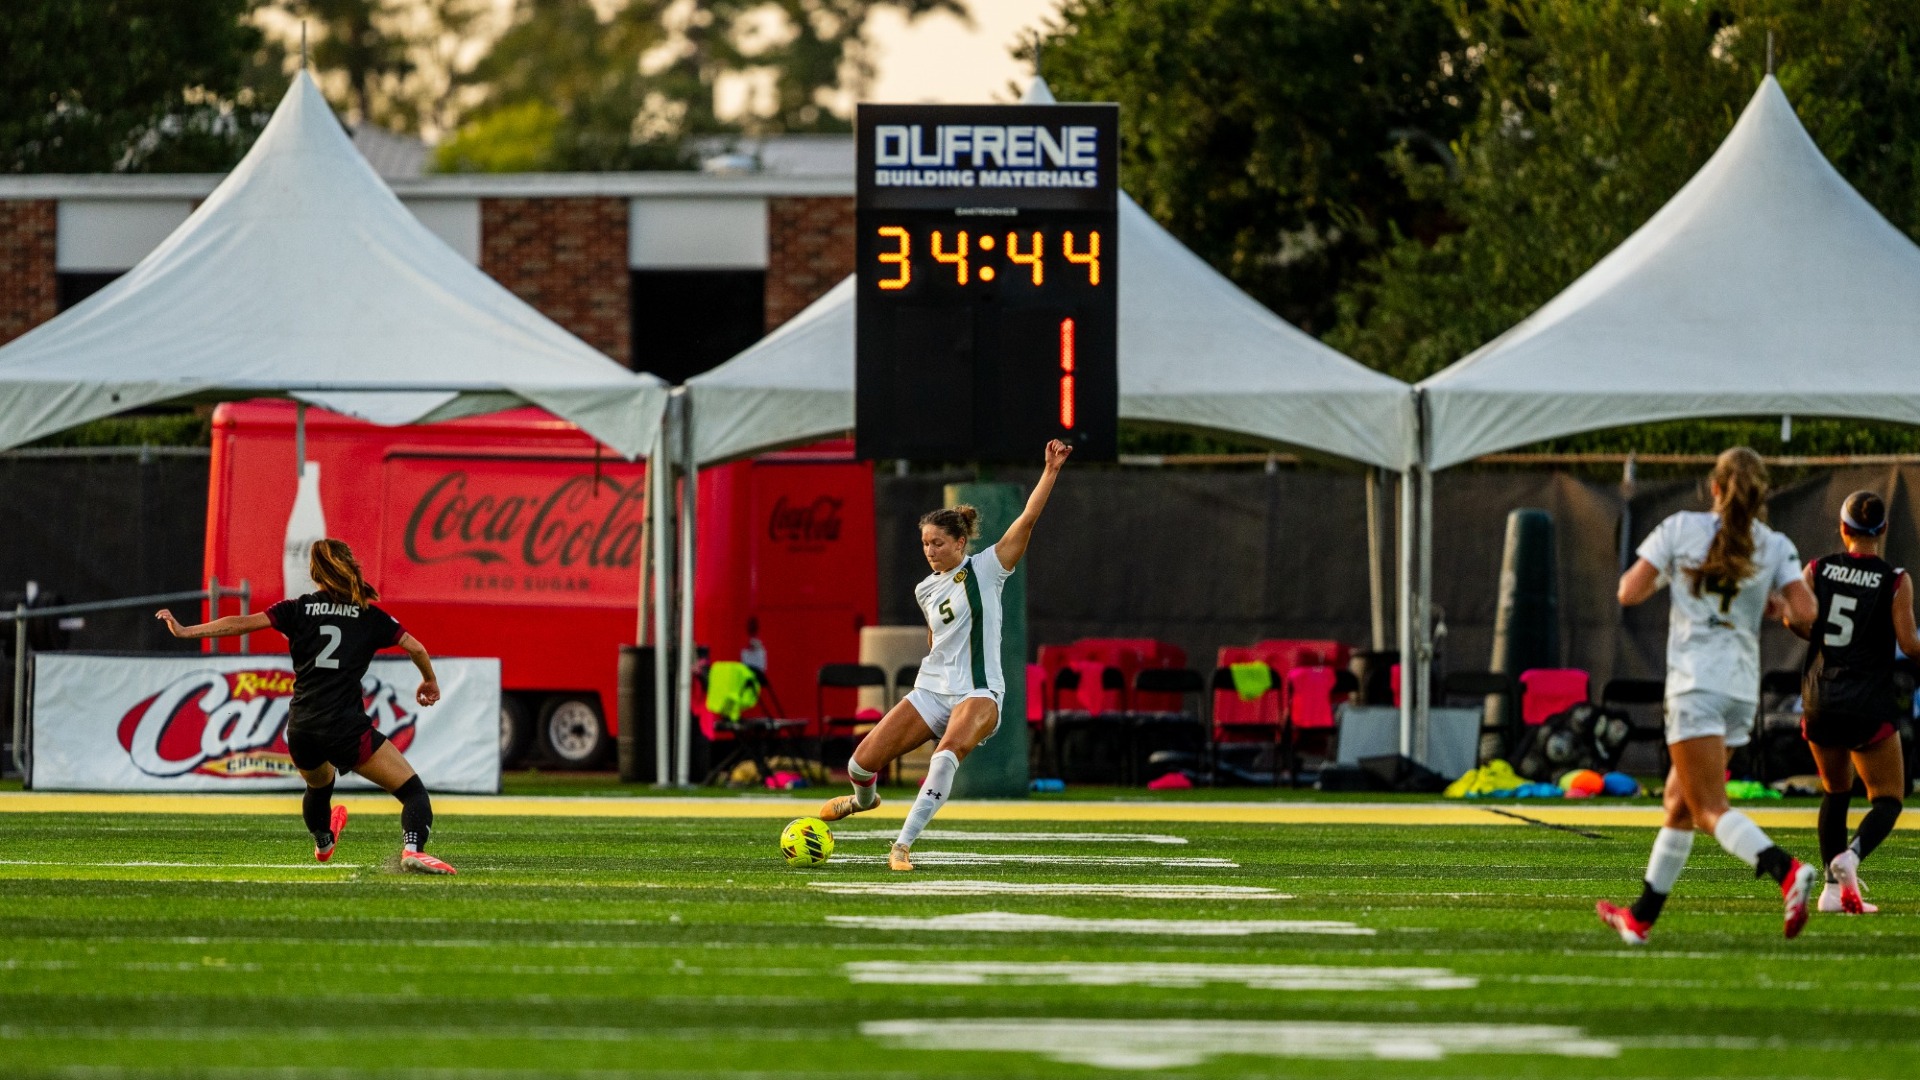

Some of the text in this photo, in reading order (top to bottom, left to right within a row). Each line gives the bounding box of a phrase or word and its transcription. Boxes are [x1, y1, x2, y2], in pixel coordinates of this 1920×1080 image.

[875, 125, 1098, 167] DUFRENE
[875, 170, 1098, 188] BUILDING MATERIALS
[1060, 317, 1076, 430] 1
[403, 470, 646, 568] Coca-Cola
[463, 575, 591, 591] ZERO SUGAR
[1822, 563, 1882, 588] TROJANS
[304, 602, 360, 619] TROJANS
[938, 598, 955, 625] 5
[1823, 593, 1858, 648] 5
[315, 624, 342, 670] 2
[233, 671, 294, 698] Rais
